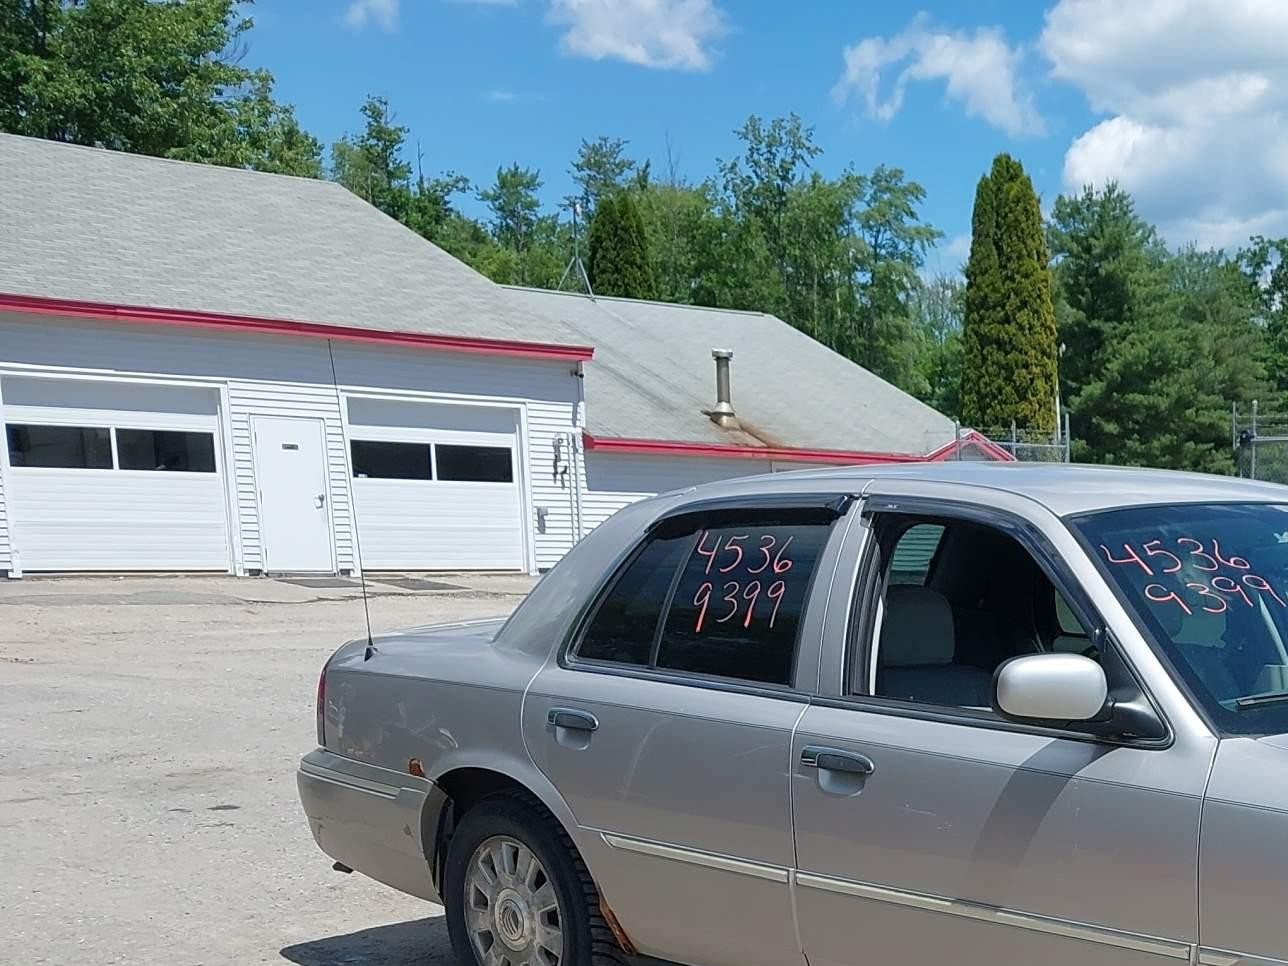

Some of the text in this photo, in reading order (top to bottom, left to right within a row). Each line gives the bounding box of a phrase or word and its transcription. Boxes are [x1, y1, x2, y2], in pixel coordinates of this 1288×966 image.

[697, 531, 794, 575] 4536
[1100, 538, 1250, 575] 4536
[693, 580, 786, 633] 9399
[1144, 574, 1287, 615] 9399
